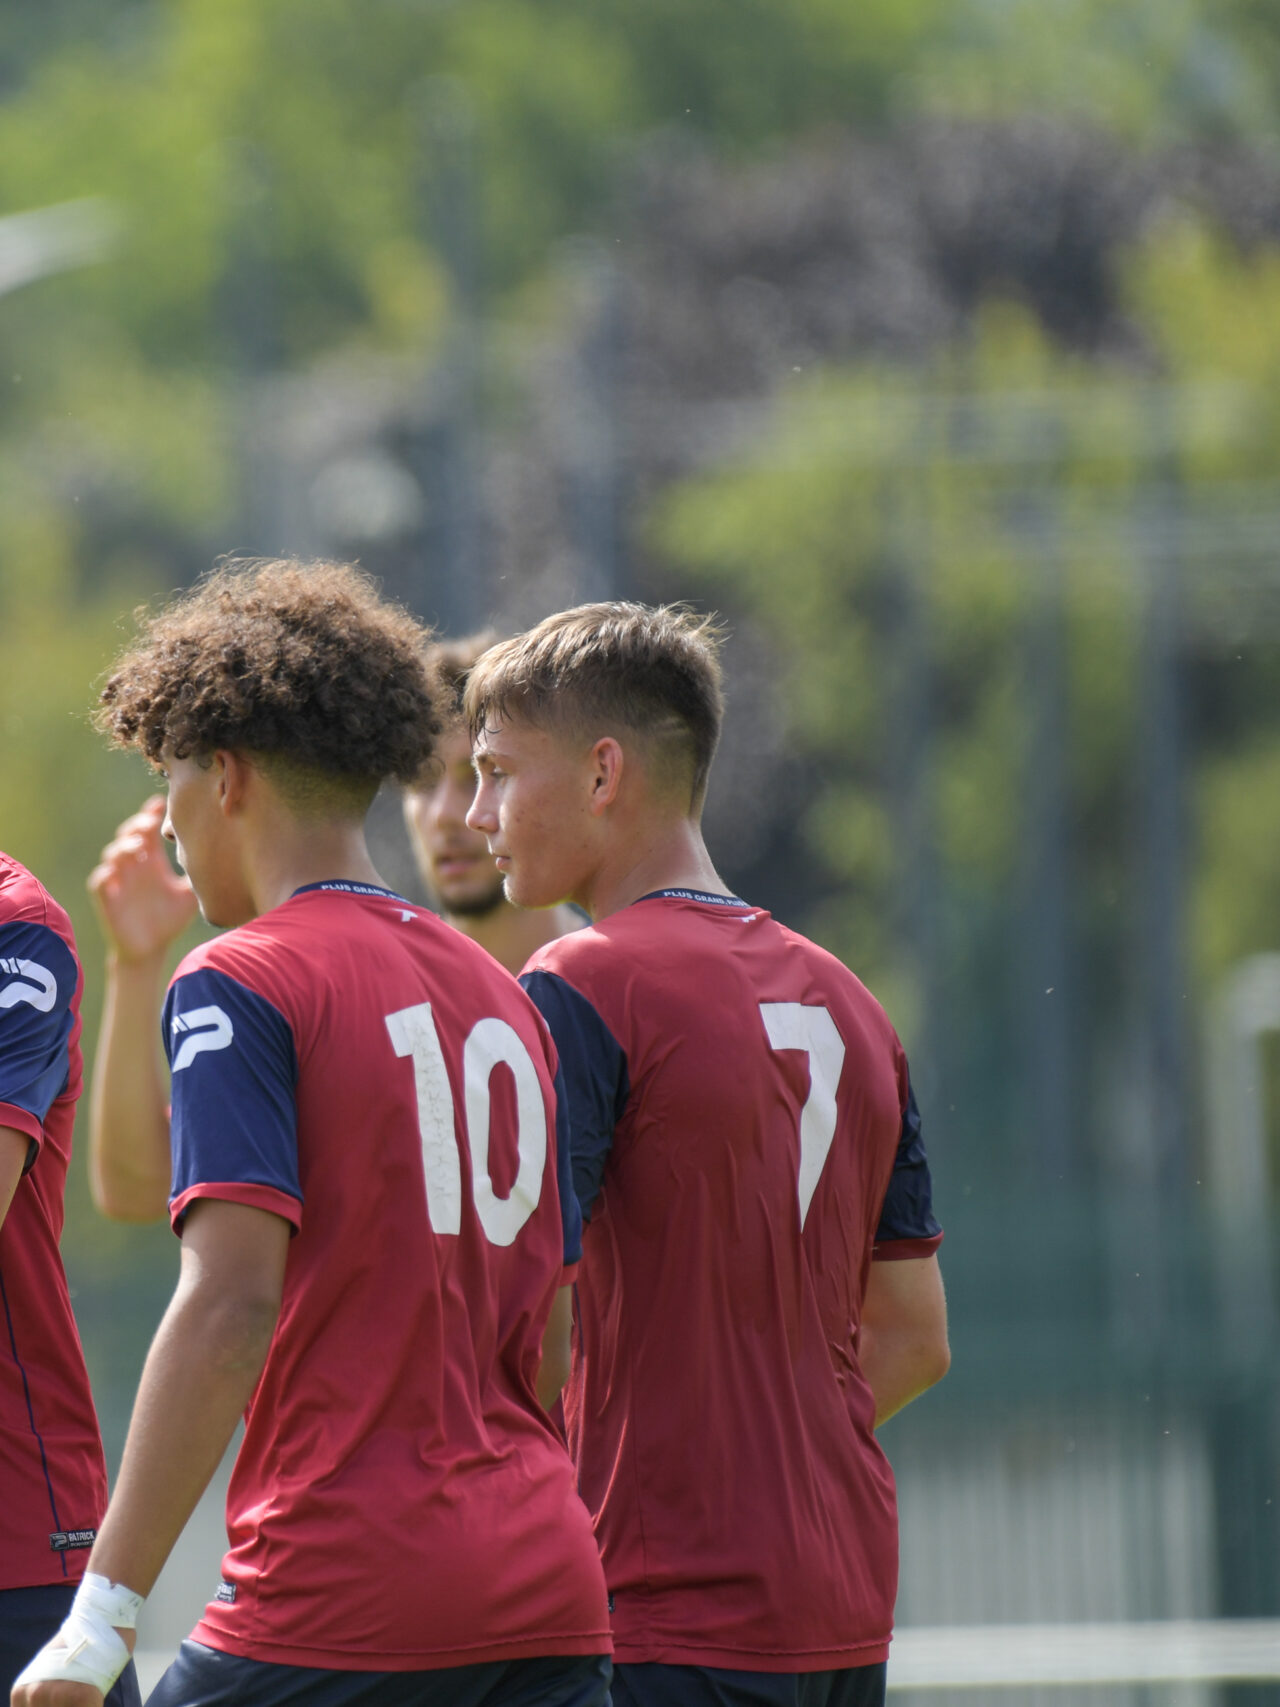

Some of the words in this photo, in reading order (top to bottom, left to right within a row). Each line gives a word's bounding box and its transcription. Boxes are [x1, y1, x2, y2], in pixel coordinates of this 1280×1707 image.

[321, 884, 352, 892] PLUS
[663, 891, 693, 900] PLUS
[384, 1001, 547, 1247] 10
[758, 1002, 846, 1233] 7
